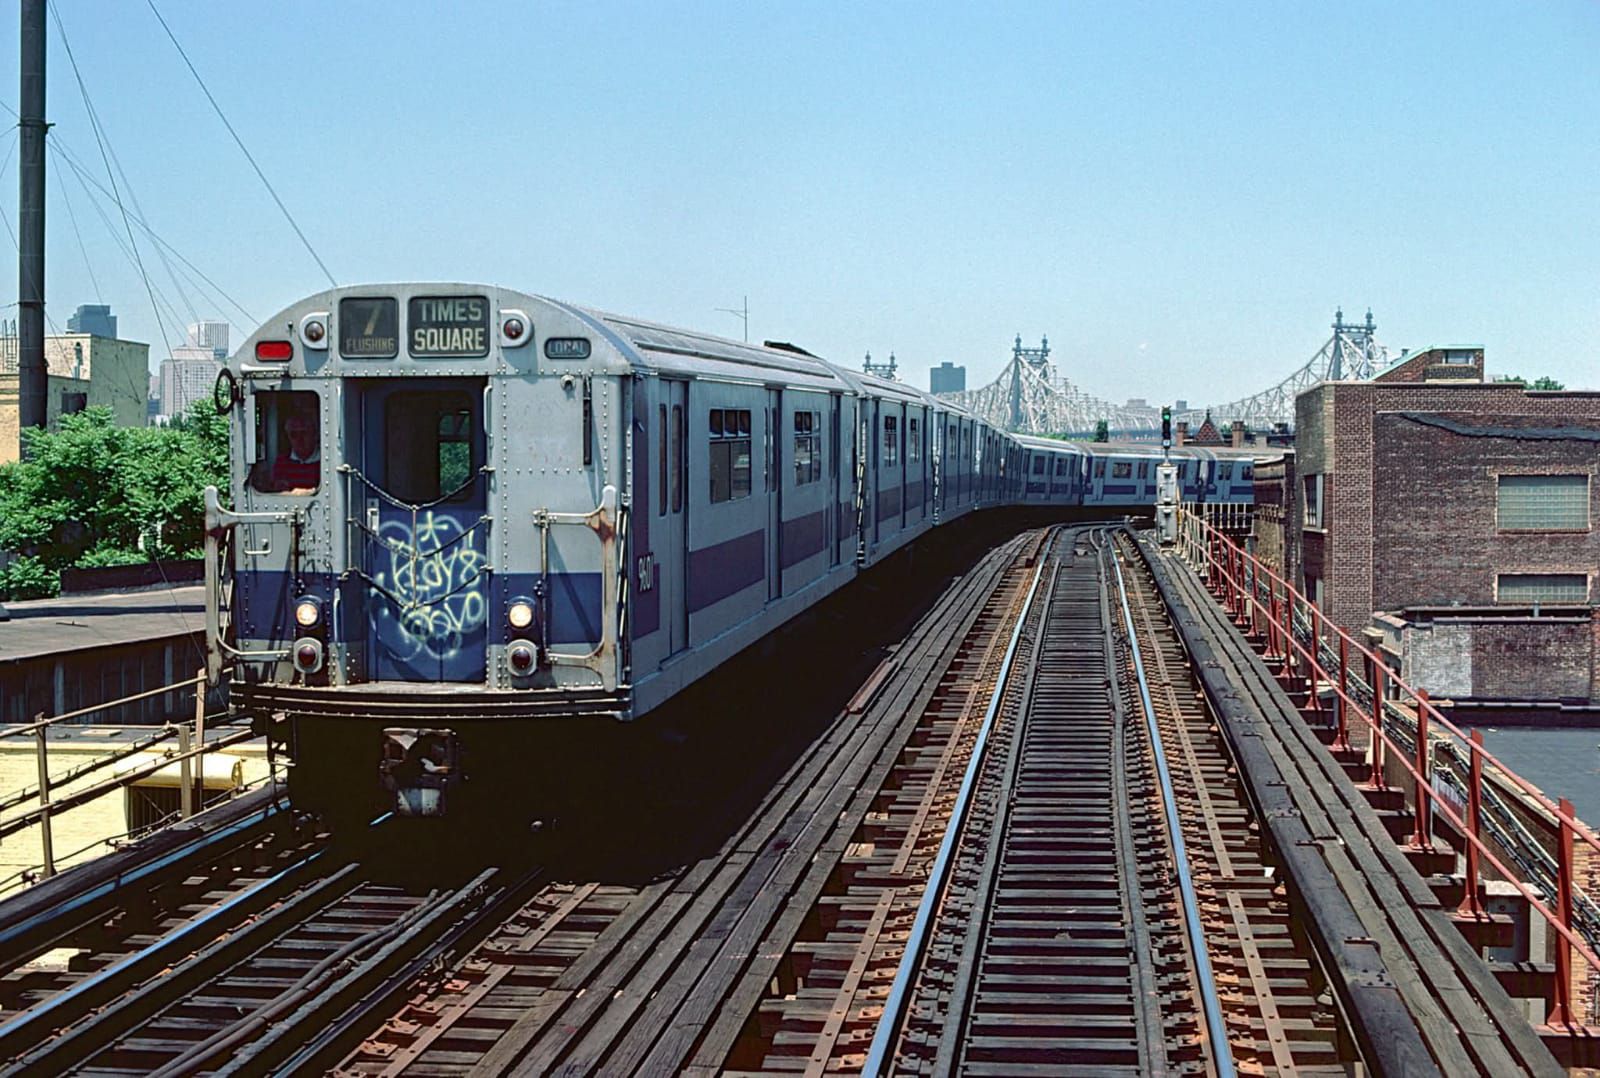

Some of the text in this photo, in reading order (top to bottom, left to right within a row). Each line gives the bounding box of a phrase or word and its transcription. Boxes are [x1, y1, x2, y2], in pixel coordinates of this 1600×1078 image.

[353, 302, 383, 336] 7
[420, 301, 482, 322] TIMES
[345, 337, 395, 352] FLUSHING
[414, 328, 485, 351] SQUARE
[638, 554, 654, 592] 9601
